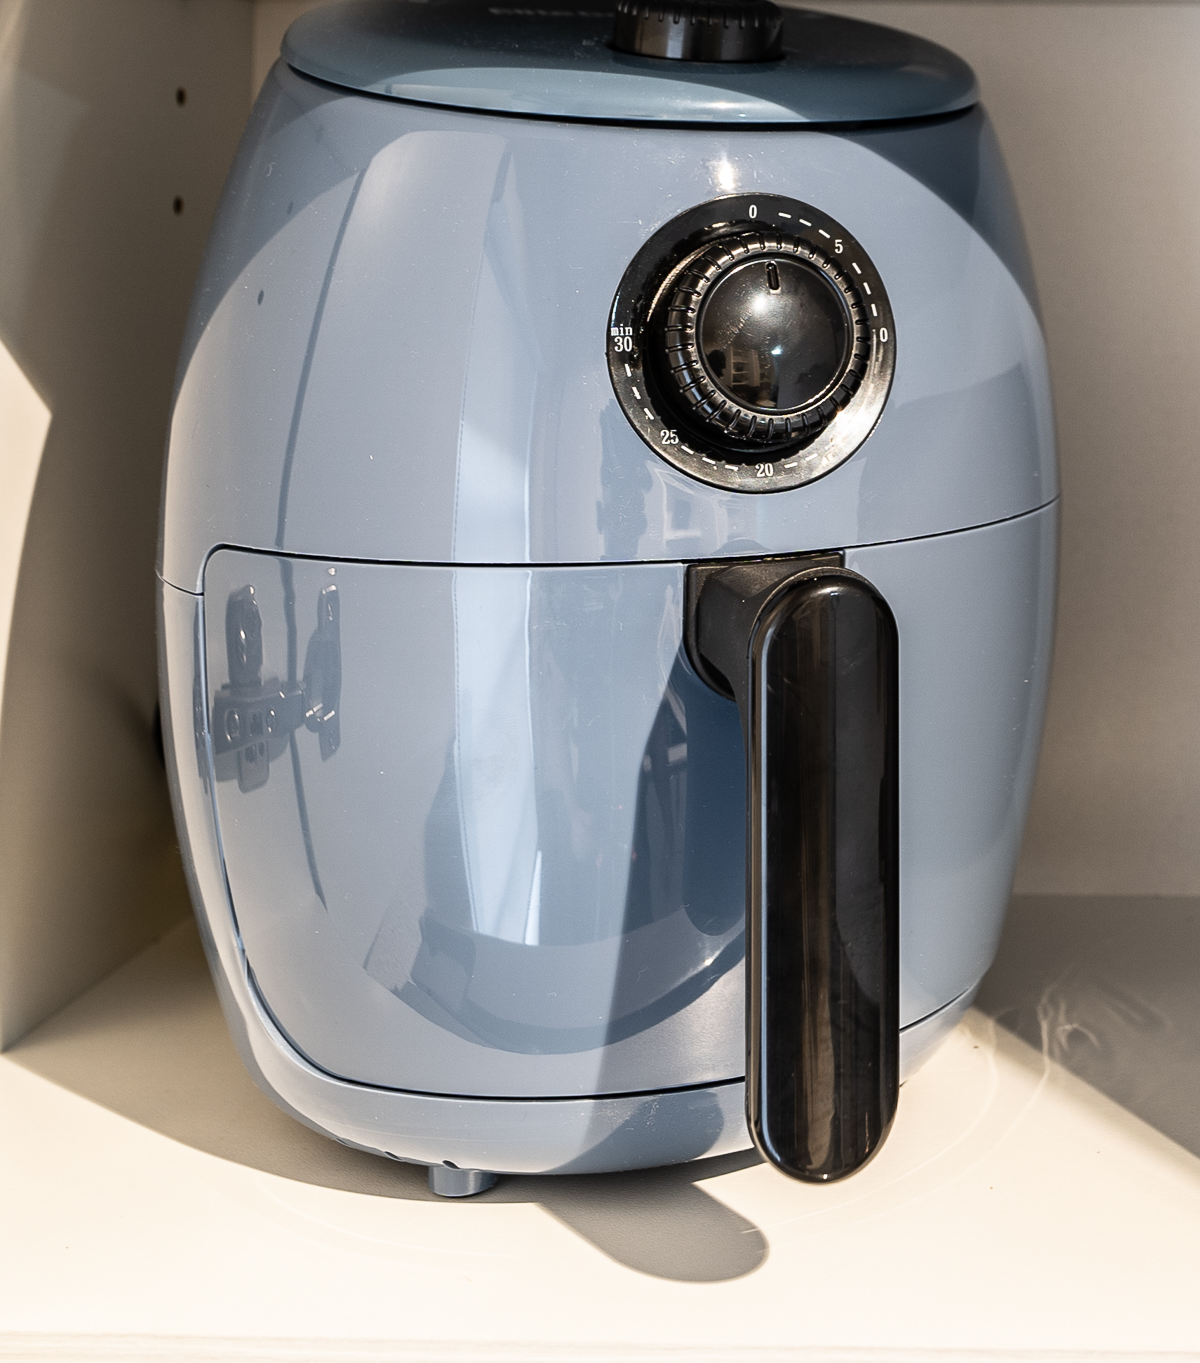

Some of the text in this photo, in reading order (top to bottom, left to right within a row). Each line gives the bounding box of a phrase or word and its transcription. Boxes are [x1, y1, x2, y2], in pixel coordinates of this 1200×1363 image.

[748, 204, 758, 219] 0
[834, 239, 844, 254] 5
[610, 323, 633, 336] min
[614, 336, 633, 352] 30
[660, 429, 680, 445] 25
[757, 463, 774, 478] 20
